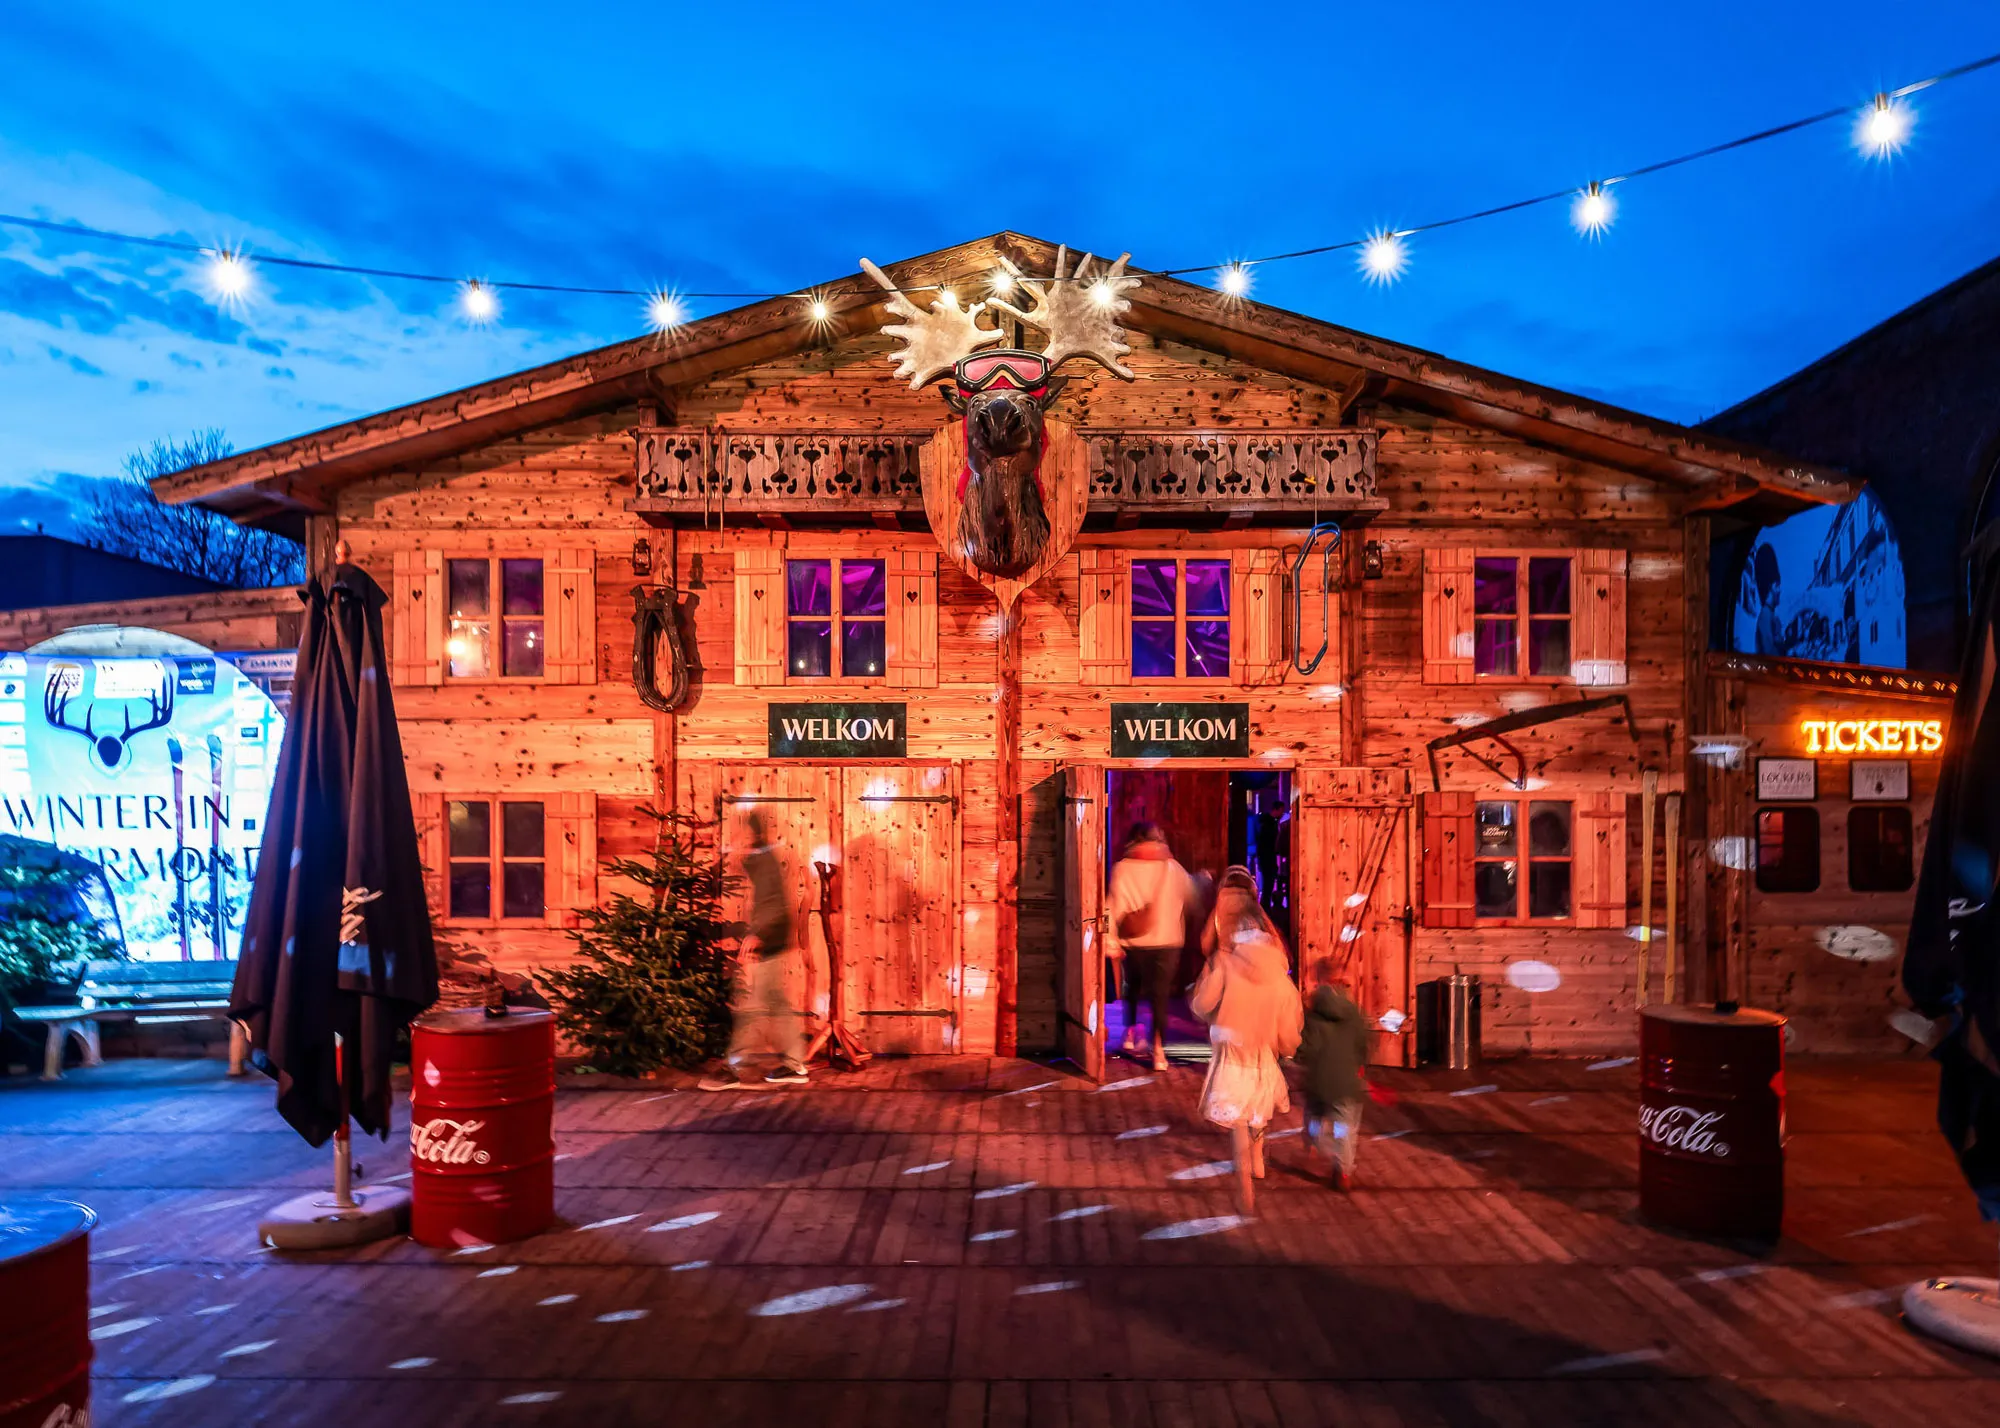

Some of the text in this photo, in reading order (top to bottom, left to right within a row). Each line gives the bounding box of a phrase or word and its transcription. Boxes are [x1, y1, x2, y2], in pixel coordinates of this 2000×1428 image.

[781, 718, 894, 741] WELKOM
[1123, 718, 1237, 741] WELKOM
[1802, 719, 1943, 753] TICKETS
[2, 793, 230, 830] WINTER IN
